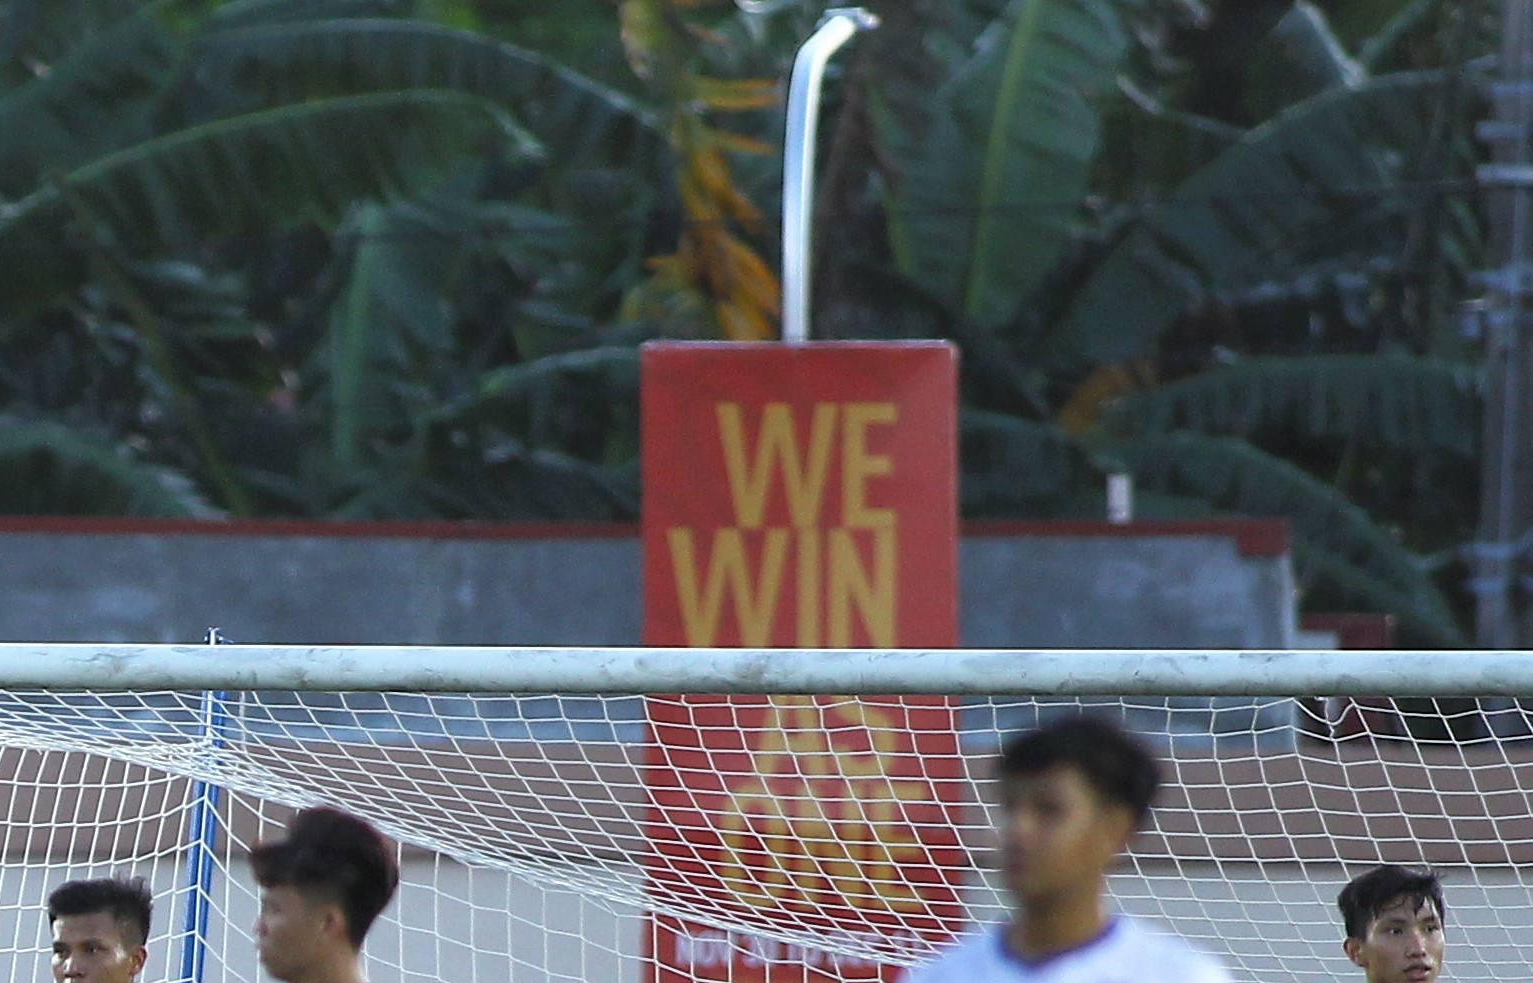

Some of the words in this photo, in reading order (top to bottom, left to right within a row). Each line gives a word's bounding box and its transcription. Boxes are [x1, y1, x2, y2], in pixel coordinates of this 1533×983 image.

[716, 401, 899, 529] WE
[666, 527, 899, 648] WIN
[721, 784, 925, 911] ONE
